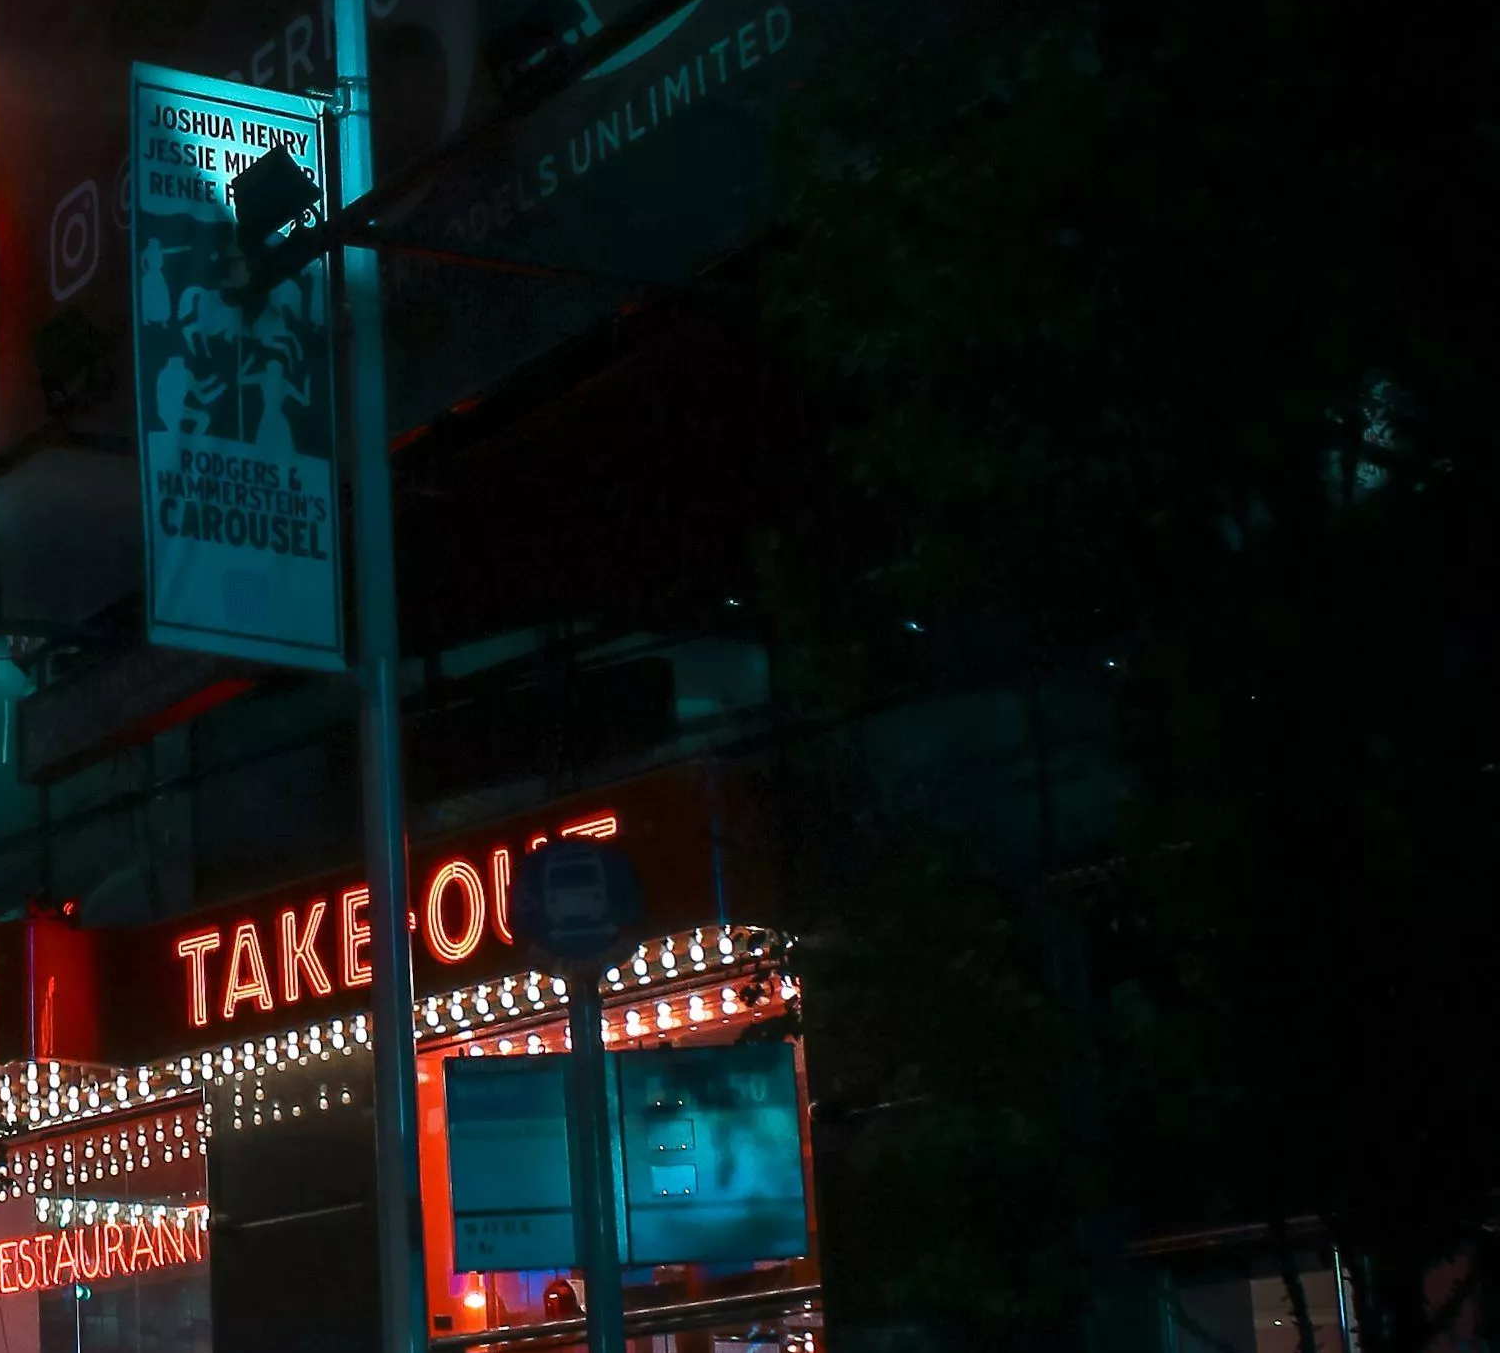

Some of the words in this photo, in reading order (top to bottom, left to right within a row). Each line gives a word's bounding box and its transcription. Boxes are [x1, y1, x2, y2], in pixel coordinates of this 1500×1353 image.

[570, 2, 795, 174] UNLIMITED
[144, 137, 217, 172] JESSIE
[148, 103, 236, 142] JOSHUA
[242, 121, 309, 157] HENRY
[181, 448, 280, 489] RODGERS
[156, 469, 328, 522] HAMMERSTEIN'S
[159, 496, 329, 561] CAROUSEL
